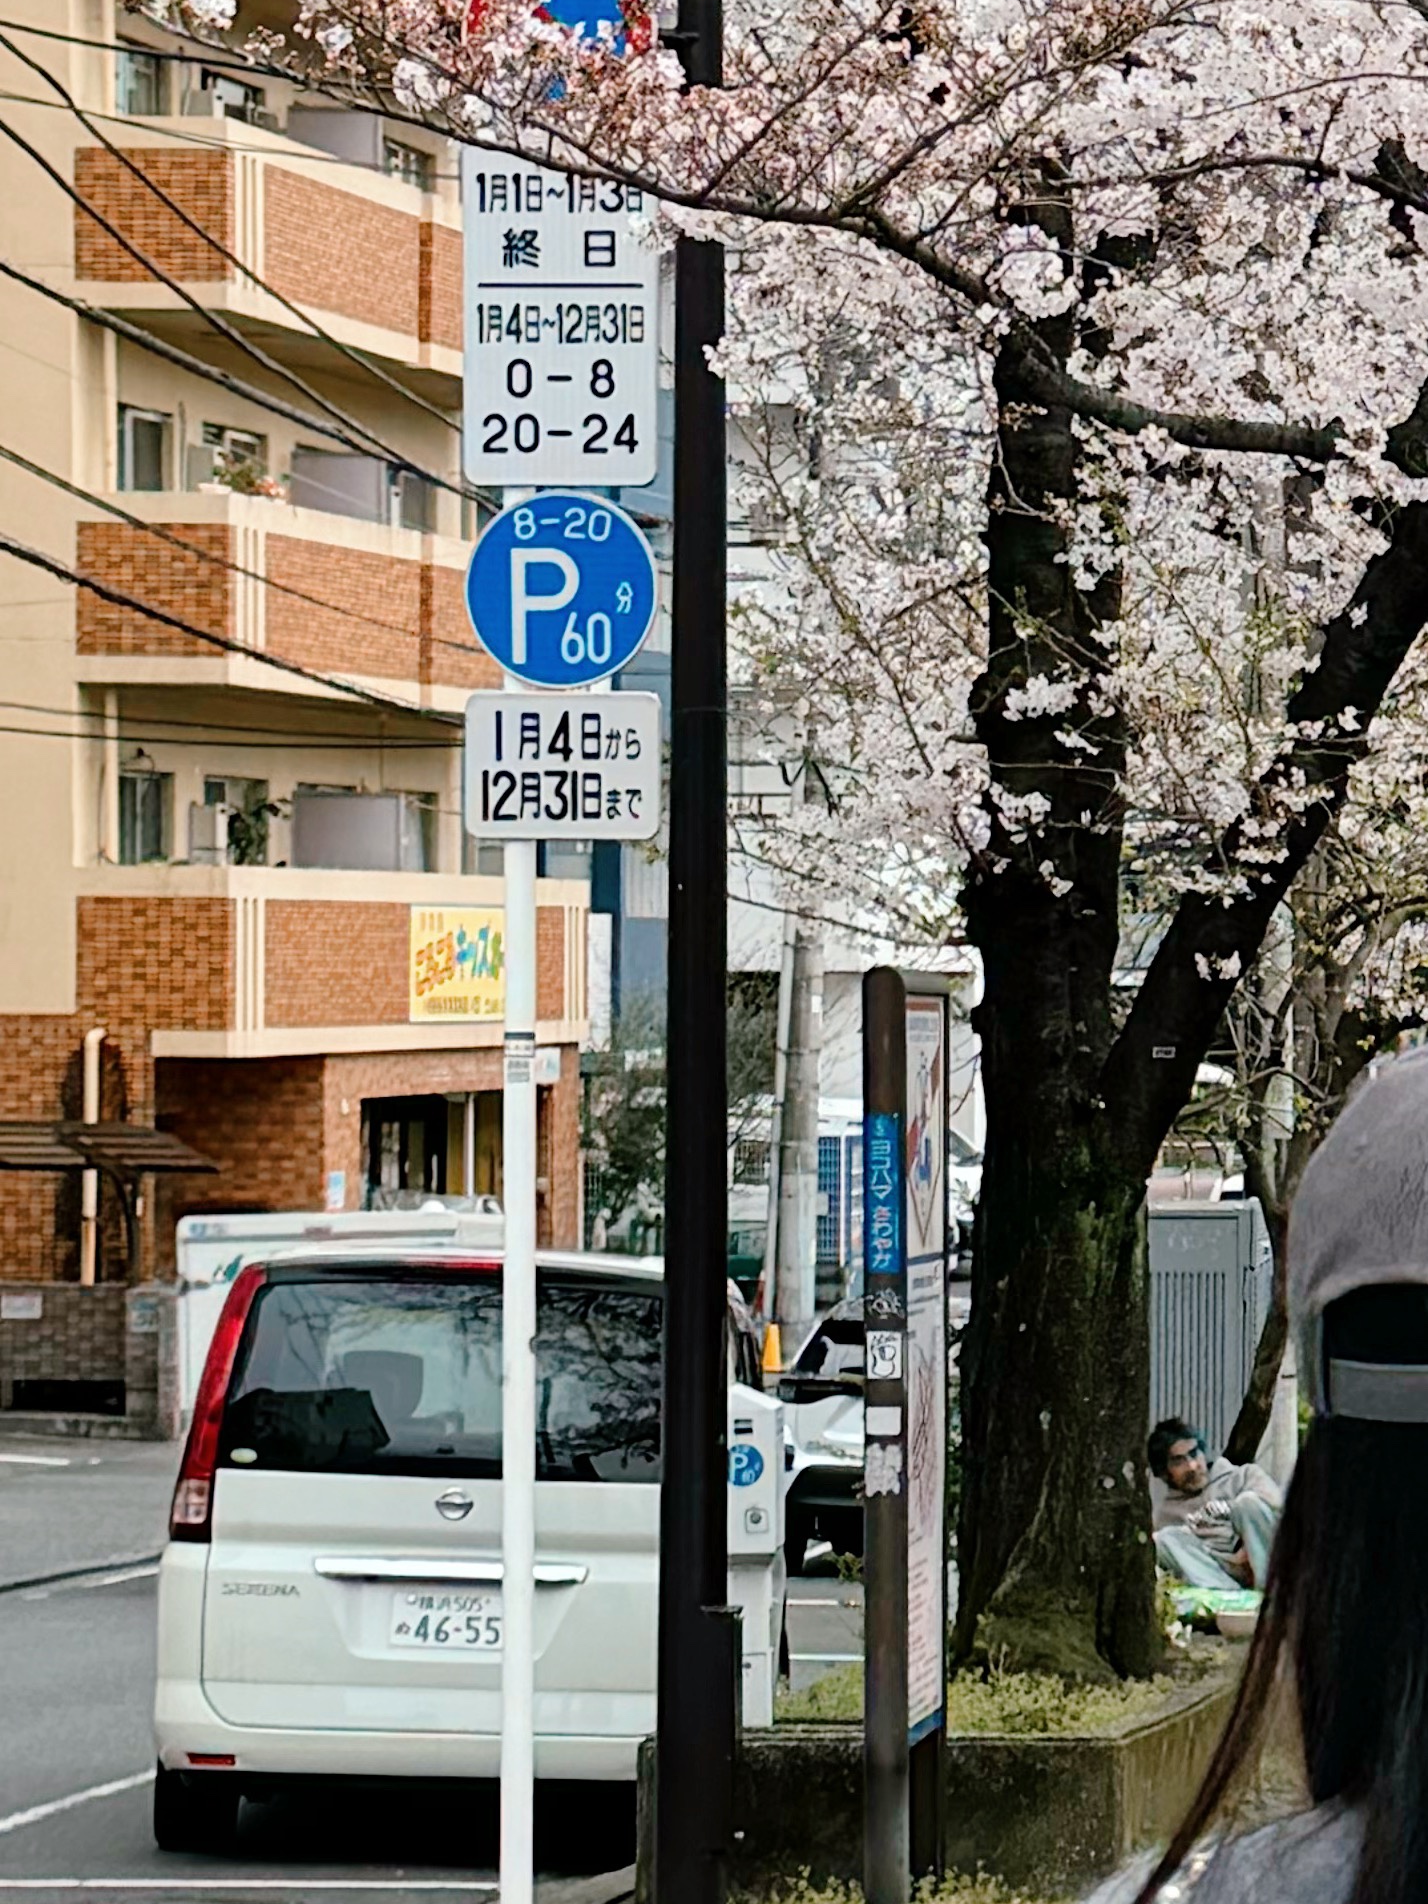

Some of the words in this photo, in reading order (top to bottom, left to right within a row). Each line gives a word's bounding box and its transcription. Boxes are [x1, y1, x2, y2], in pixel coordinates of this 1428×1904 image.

[477, 303, 645, 344] 1月4日~12月31日
[482, 412, 639, 455] 20-24
[513, 507, 612, 542] 8-20
[510, 548, 581, 665] P
[560, 611, 612, 665] 60
[494, 710, 642, 763] 1月4日から
[481, 769, 643, 823] 12月31日まで
